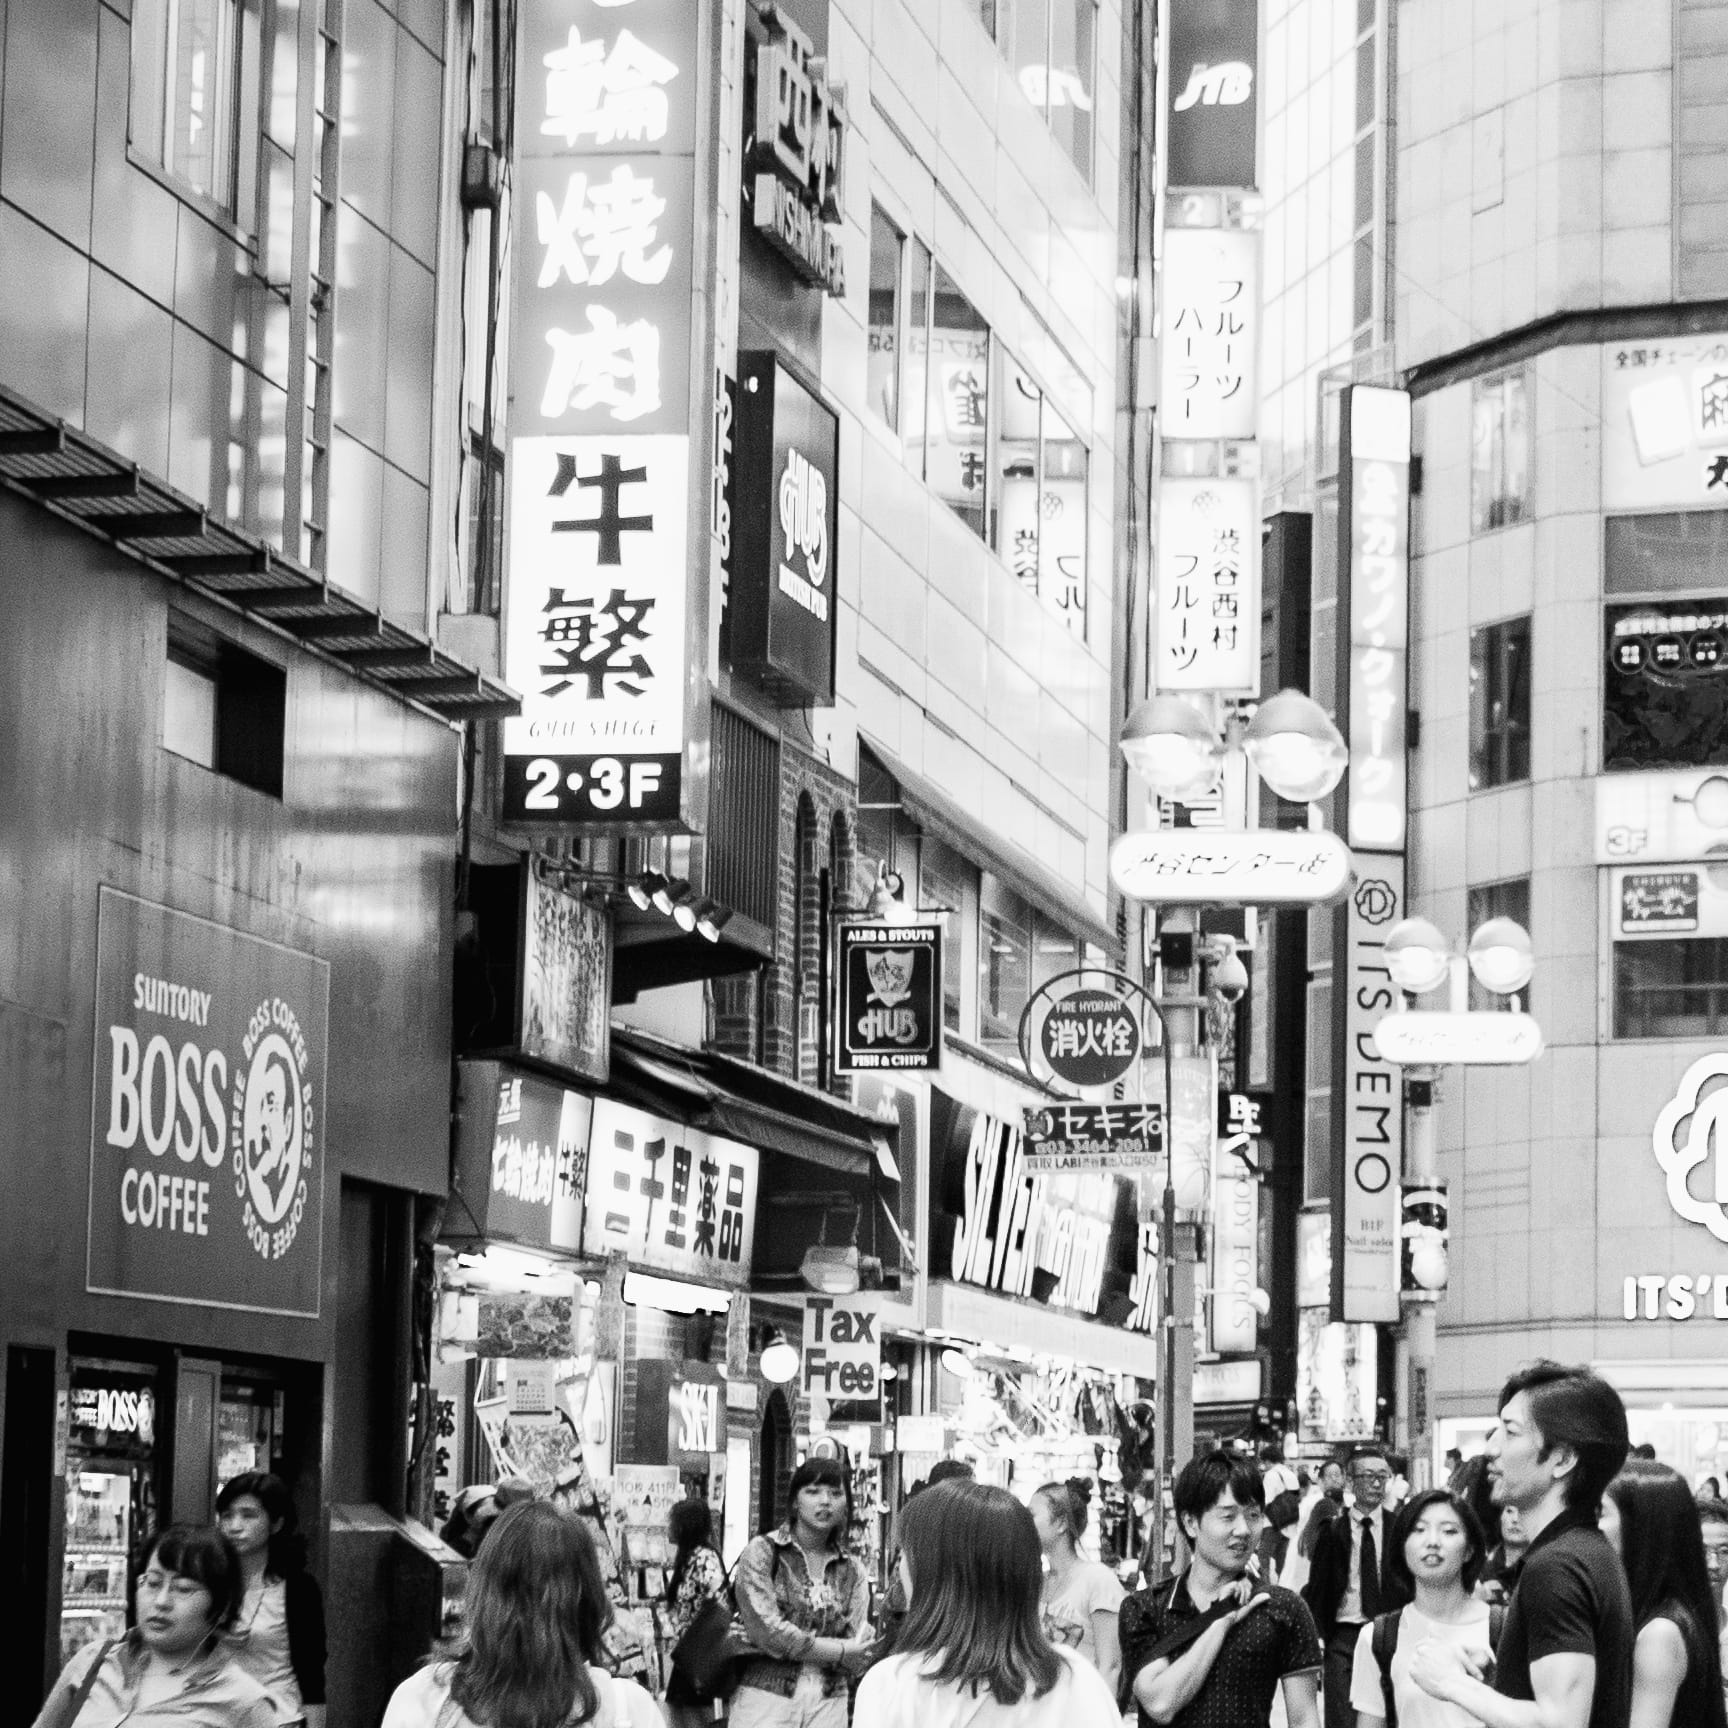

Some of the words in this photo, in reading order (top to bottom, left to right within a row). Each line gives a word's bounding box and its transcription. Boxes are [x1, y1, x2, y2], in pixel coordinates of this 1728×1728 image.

[1174, 61, 1254, 112] JTB
[537, 452, 656, 701] 牛繁
[1170, 554, 1200, 672] フルーツ
[847, 930, 877, 941] ALES
[888, 929, 935, 941] STOUTS
[857, 1008, 919, 1045] HUB
[1055, 1001, 1076, 1013] FIRE
[1079, 1000, 1123, 1013] HYDRANT
[1048, 1017, 1133, 1058] 消火栓
[851, 1054, 880, 1067] FISH
[891, 1054, 928, 1067] CHIPS
[106, 1025, 228, 1168] BOSS
[1058, 1105, 1163, 1140] セキネ
[121, 1167, 210, 1236] COFFEE
[804, 1298, 878, 1346] Tax
[804, 1353, 877, 1395] Free
